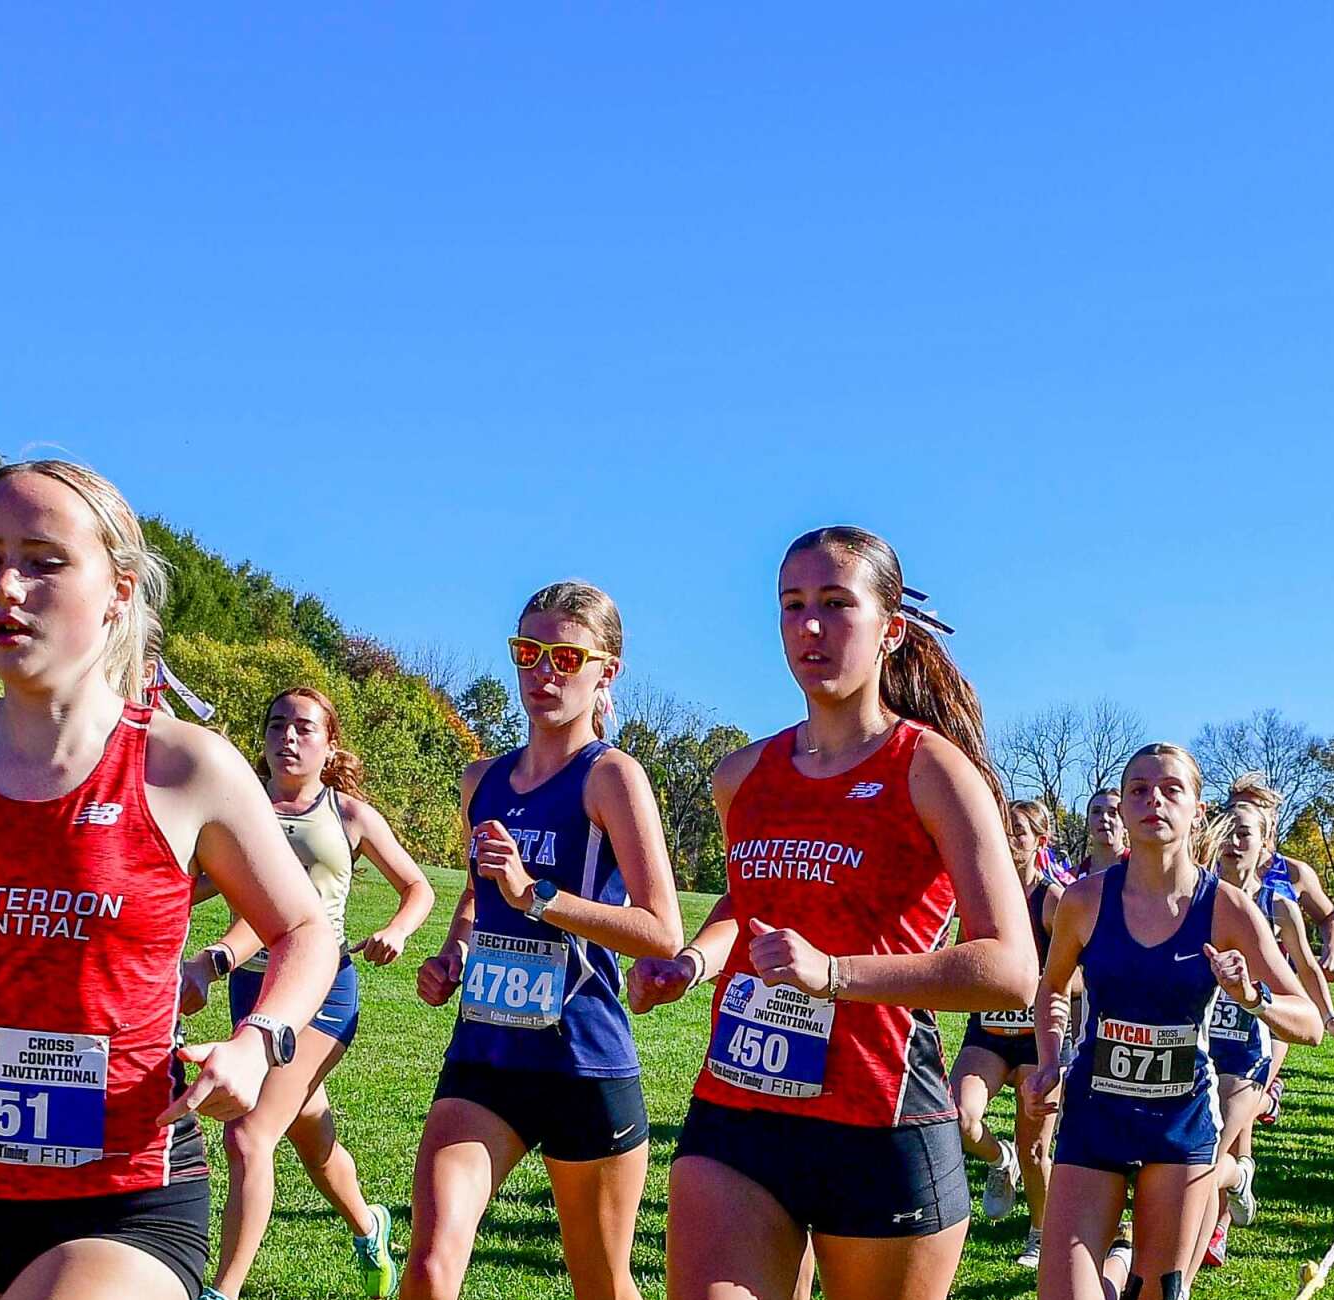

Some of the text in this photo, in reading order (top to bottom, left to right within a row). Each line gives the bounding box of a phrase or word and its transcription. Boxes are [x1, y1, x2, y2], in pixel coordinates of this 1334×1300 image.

[729, 839, 863, 869] HUNTERDON
[741, 860, 835, 884] CENTRAL
[477, 933, 539, 955] SECTION
[542, 942, 553, 956] 1
[467, 962, 555, 1011] 4784
[775, 988, 811, 1005] CROSS
[766, 999, 816, 1019] COUNTRY
[754, 1008, 825, 1034] INVITATIONAL
[28, 1037, 75, 1052] CROSS
[1104, 1022, 1153, 1046] NYCAL
[19, 1052, 83, 1068] COUNTRY
[727, 1024, 789, 1073] 450
[2, 1064, 99, 1084] INVITATIONAL
[1110, 1045, 1173, 1081] 671
[771, 1079, 804, 1096] FAT
[41, 1148, 81, 1165] FAT
